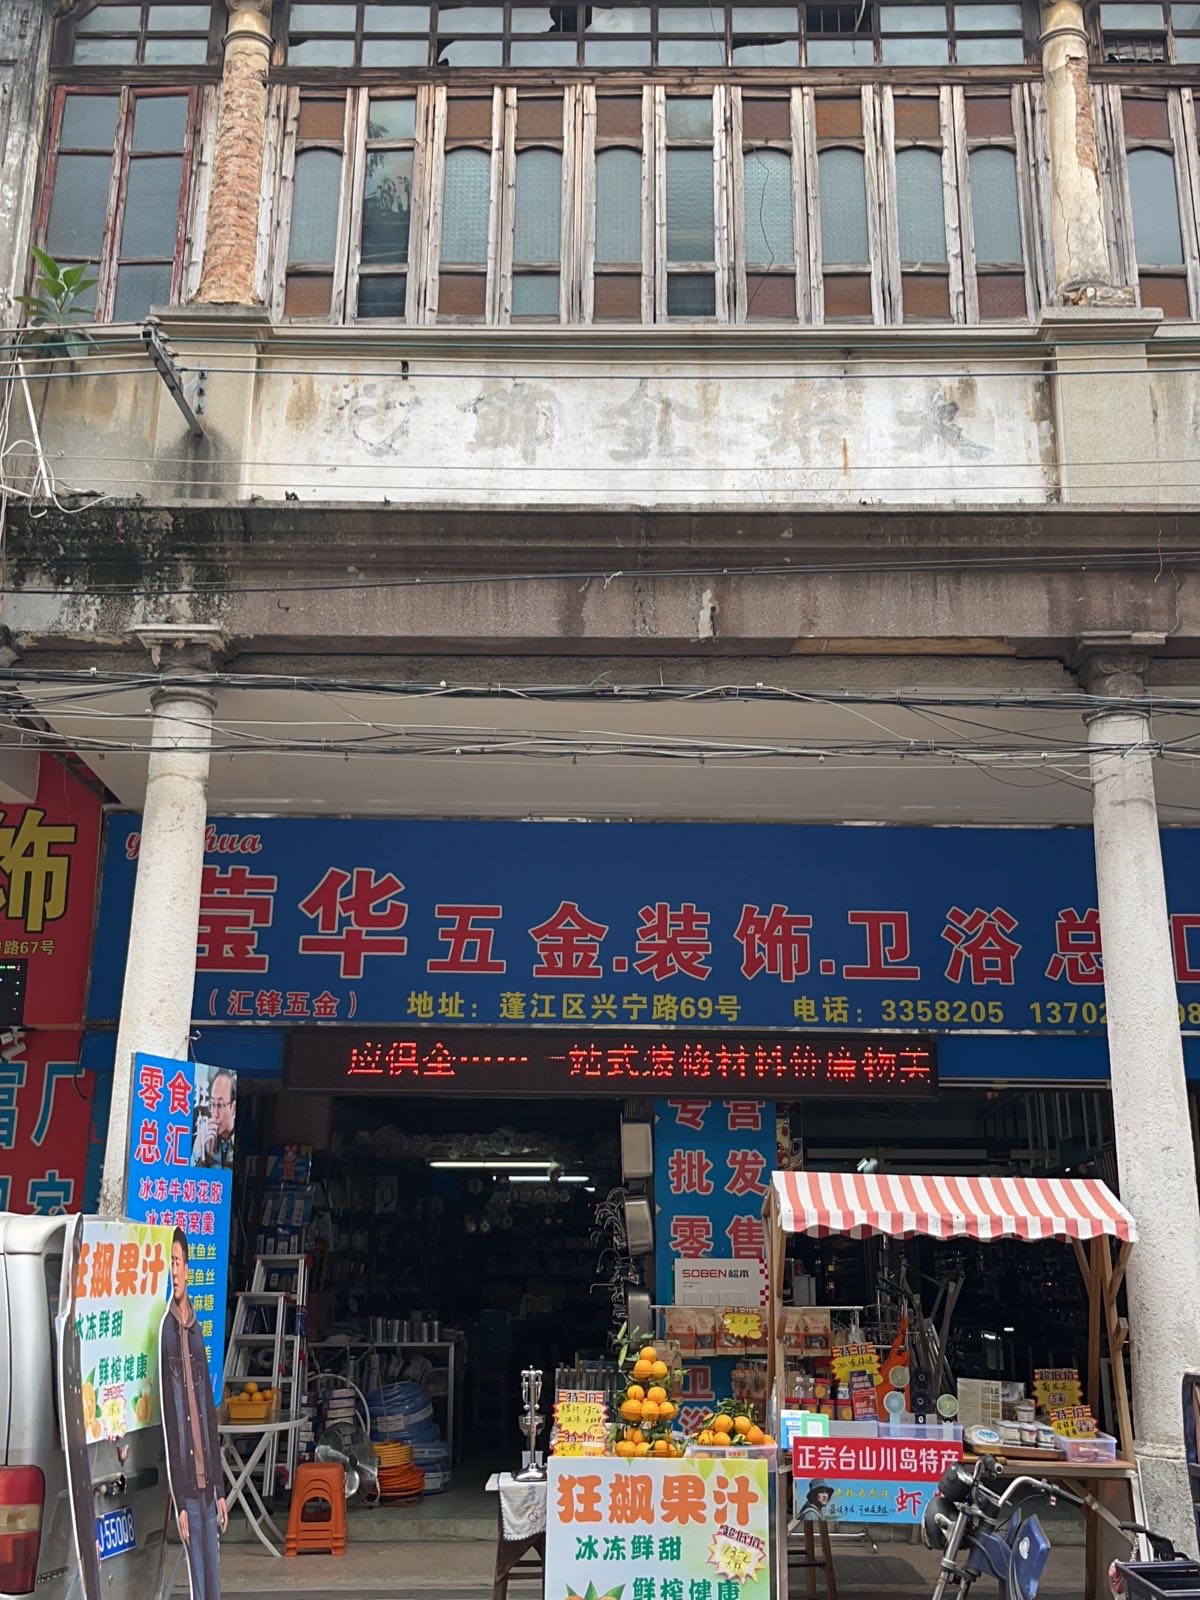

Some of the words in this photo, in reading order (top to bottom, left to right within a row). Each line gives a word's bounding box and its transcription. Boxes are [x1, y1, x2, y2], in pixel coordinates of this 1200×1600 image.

[0, 939, 55, 956] 路67号
[138, 1065, 192, 1117] 零食
[134, 1119, 191, 1166] 总汇
[668, 1149, 768, 1196] 批发
[139, 1176, 223, 1205] 冰冻牛奶花胶
[669, 1215, 766, 1259] 零售
[682, 1269, 727, 1278] SOBEN
[98, 1352, 148, 1386] 鲜榨健康
[567, 1392, 596, 1403] 特价
[1055, 1407, 1084, 1420] 特价
[797, 1445, 959, 1474] 正宗台山川岛特产
[556, 1472, 760, 1526] 狂飙果汁
[575, 1534, 682, 1561] 冰冻鲜甜
[723, 1525, 761, 1548] 超低价
[632, 1577, 741, 1600] 鲜榨健康
